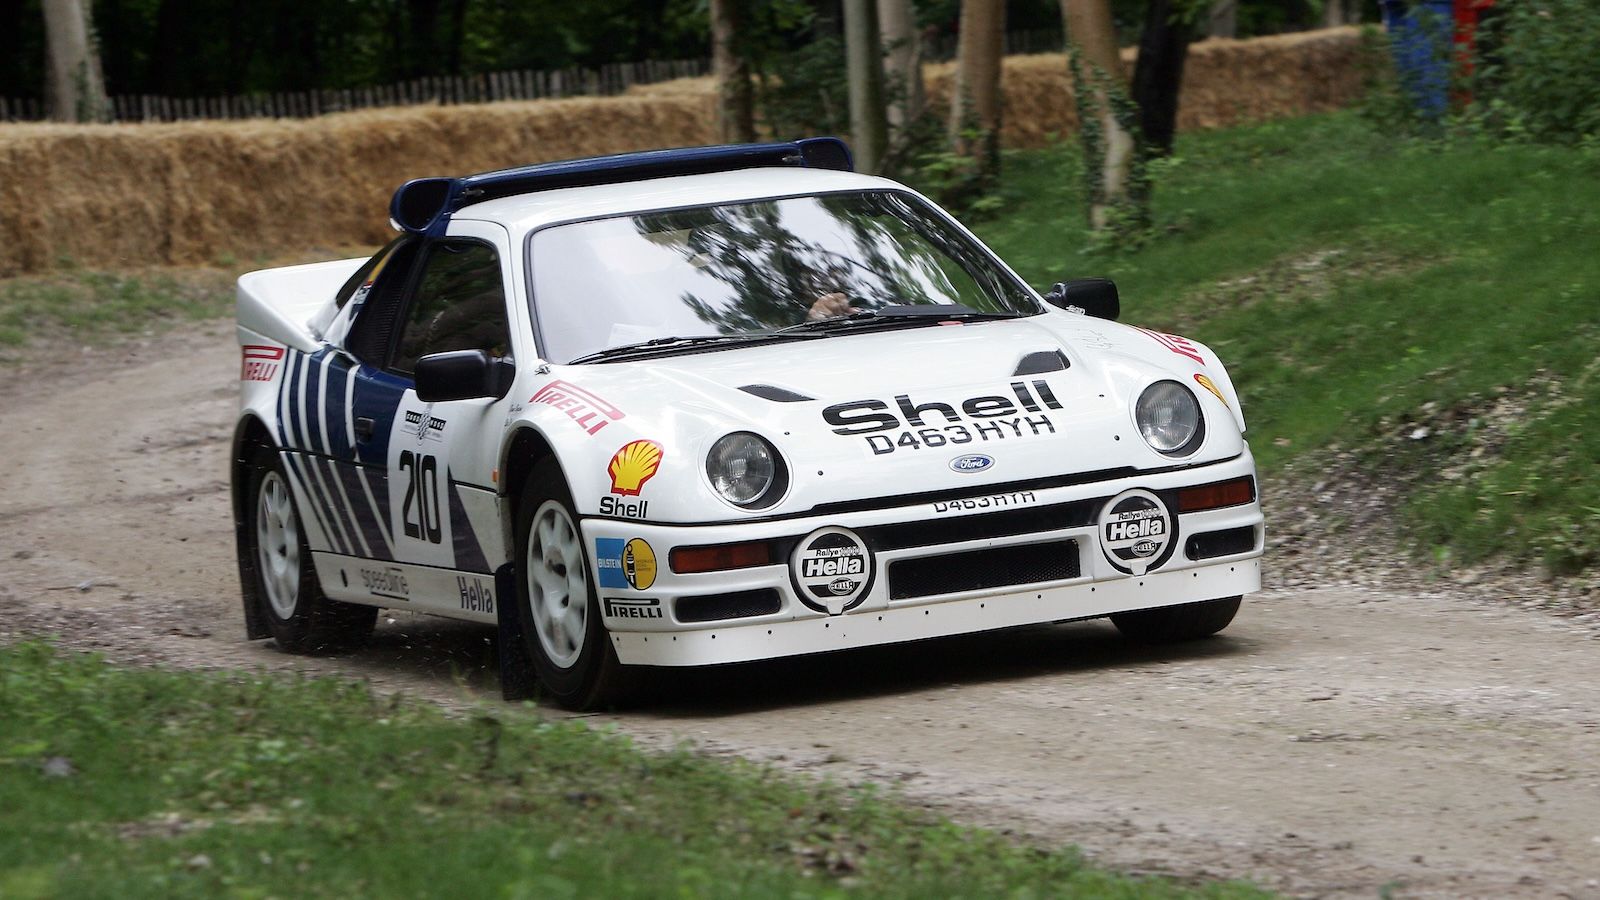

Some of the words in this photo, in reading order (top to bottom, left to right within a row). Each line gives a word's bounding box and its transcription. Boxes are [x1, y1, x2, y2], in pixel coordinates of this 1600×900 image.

[528, 379, 626, 436] PIRELLI
[822, 380, 1064, 436] Shell
[960, 457, 985, 469] Ford
[399, 449, 441, 545] 210
[600, 496, 648, 518] Shell
[1110, 519, 1162, 541] Hella
[815, 549, 839, 557] Rallye
[806, 557, 862, 577] Hella
[457, 575, 493, 614] Hella
[603, 597, 663, 618] PIRELLI
